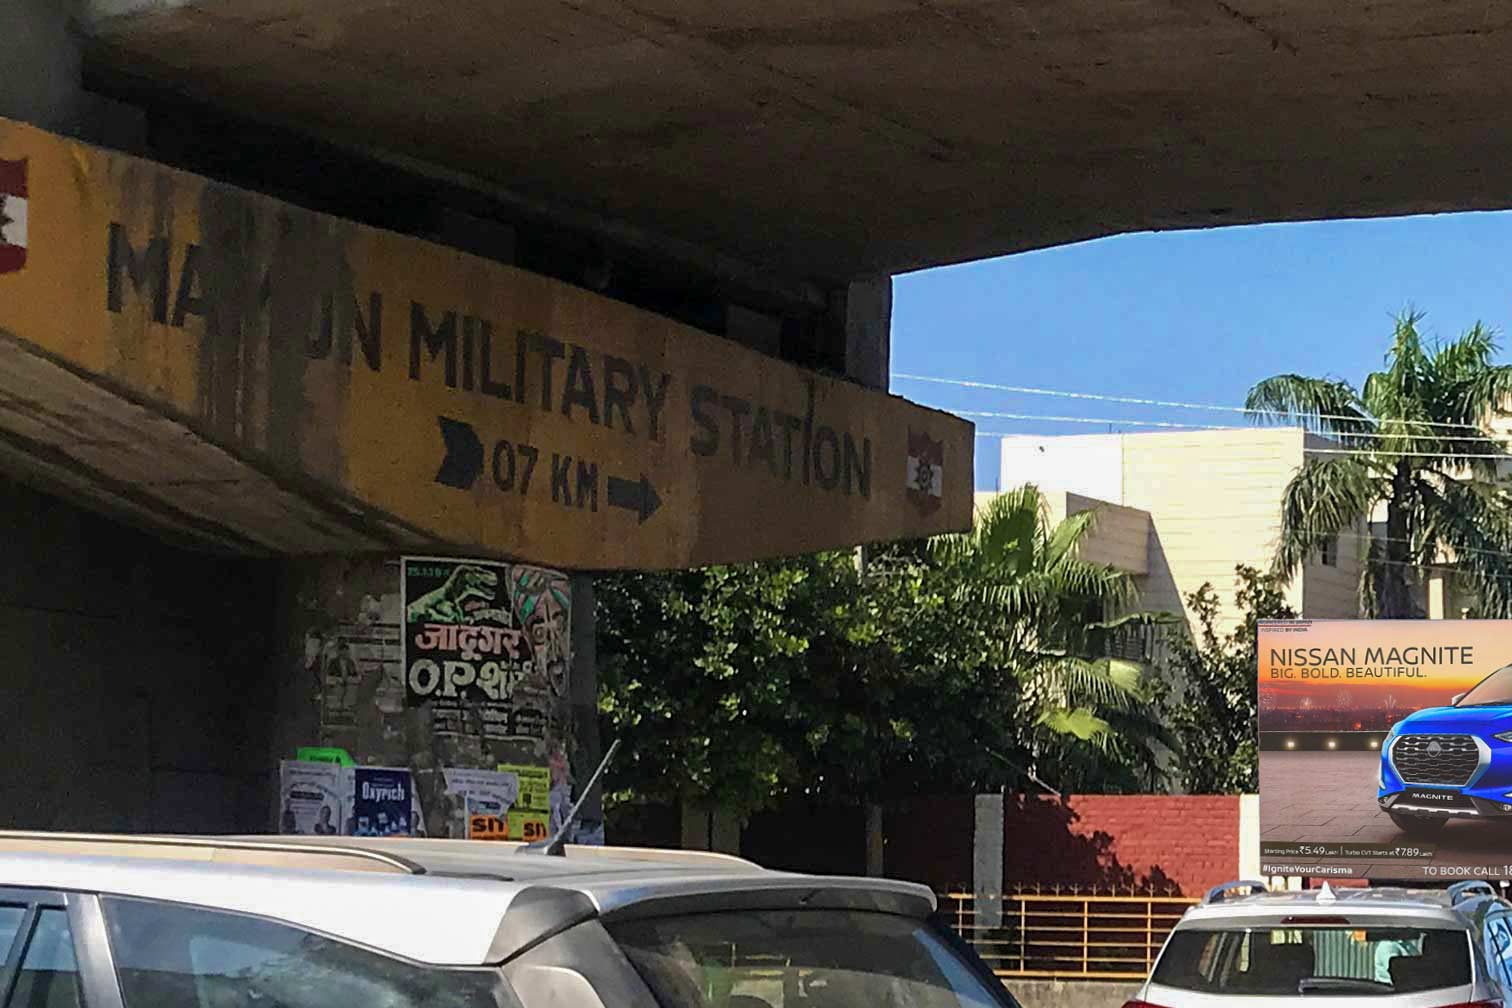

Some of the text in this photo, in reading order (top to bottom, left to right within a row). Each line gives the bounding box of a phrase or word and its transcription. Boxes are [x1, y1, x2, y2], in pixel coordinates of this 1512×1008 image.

[107, 221, 873, 497] MAN MILITARY STATION
[491, 439, 599, 513] 07 KM
[1270, 646, 1474, 667] NISSAN MAGNITE
[1270, 666, 1428, 679] BIG. BOLD. BEAUTIFUL.
[1411, 793, 1454, 801] MAGNITE
[1263, 864, 1353, 875] #IgniteYourCarisma
[1422, 866, 1437, 876] TO
[1440, 866, 1471, 876] BOOK
[1473, 866, 1501, 876] CALL
